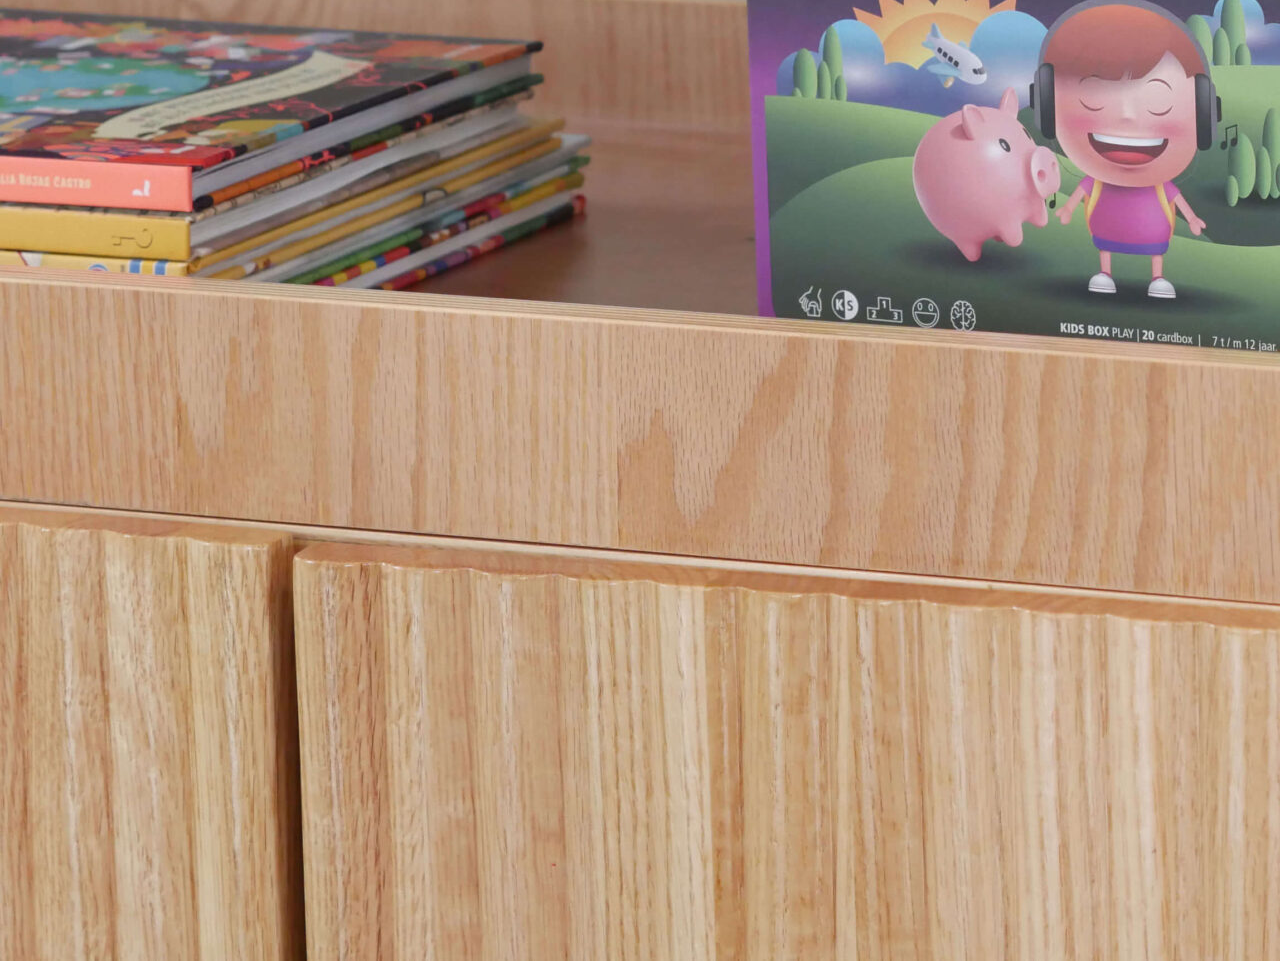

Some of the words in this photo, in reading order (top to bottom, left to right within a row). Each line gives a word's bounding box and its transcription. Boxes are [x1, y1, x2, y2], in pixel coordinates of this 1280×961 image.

[1060, 322, 1085, 335] KIDS
[1087, 324, 1110, 337] BOX
[1111, 326, 1134, 339] PLAY
[1142, 329, 1155, 341] 20
[1156, 330, 1193, 345] cardbox
[1212, 336, 1218, 347] 7
[1244, 338, 1256, 351] 12
